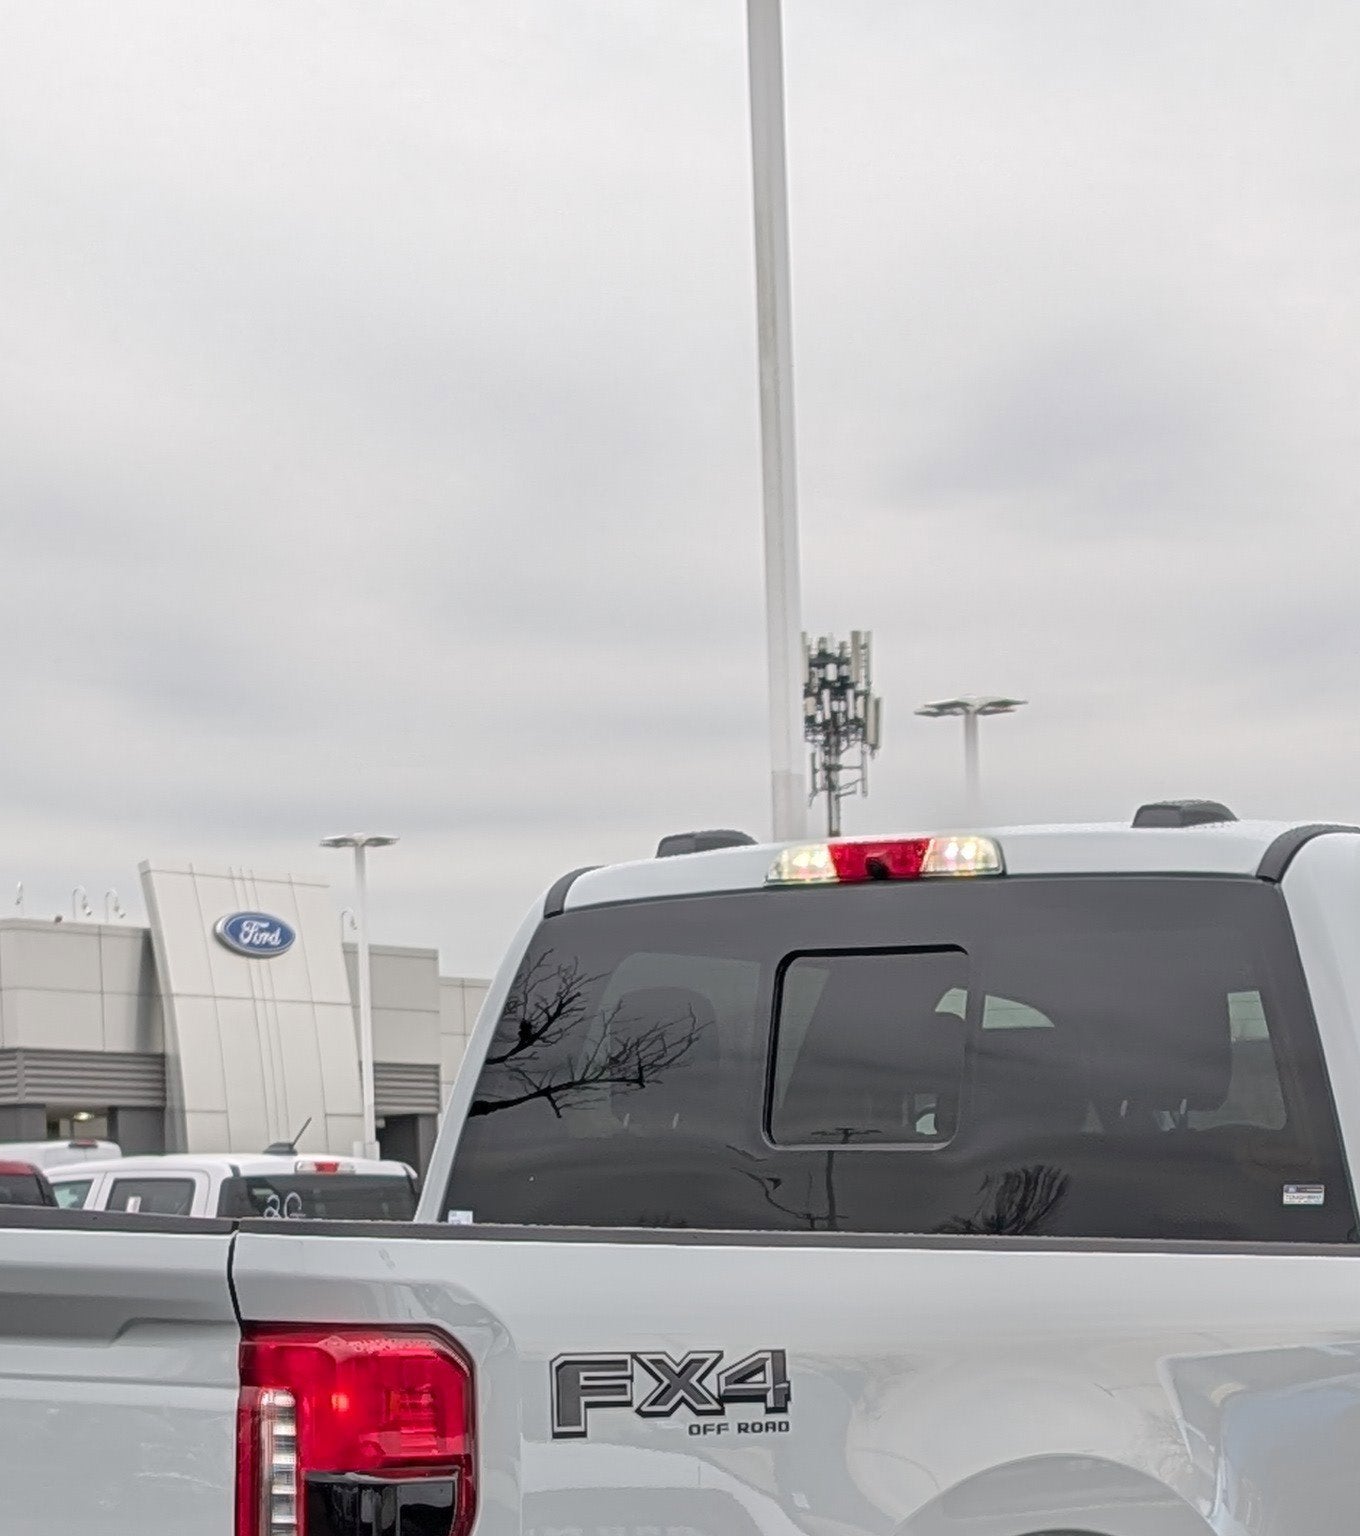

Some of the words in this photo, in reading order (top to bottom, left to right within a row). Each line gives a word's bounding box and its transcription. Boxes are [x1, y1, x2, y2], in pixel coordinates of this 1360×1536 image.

[239, 920, 281, 946] Ford
[549, 1349, 792, 1440] FX4
[687, 1422, 729, 1436] OFF
[736, 1420, 790, 1434] ROAD
